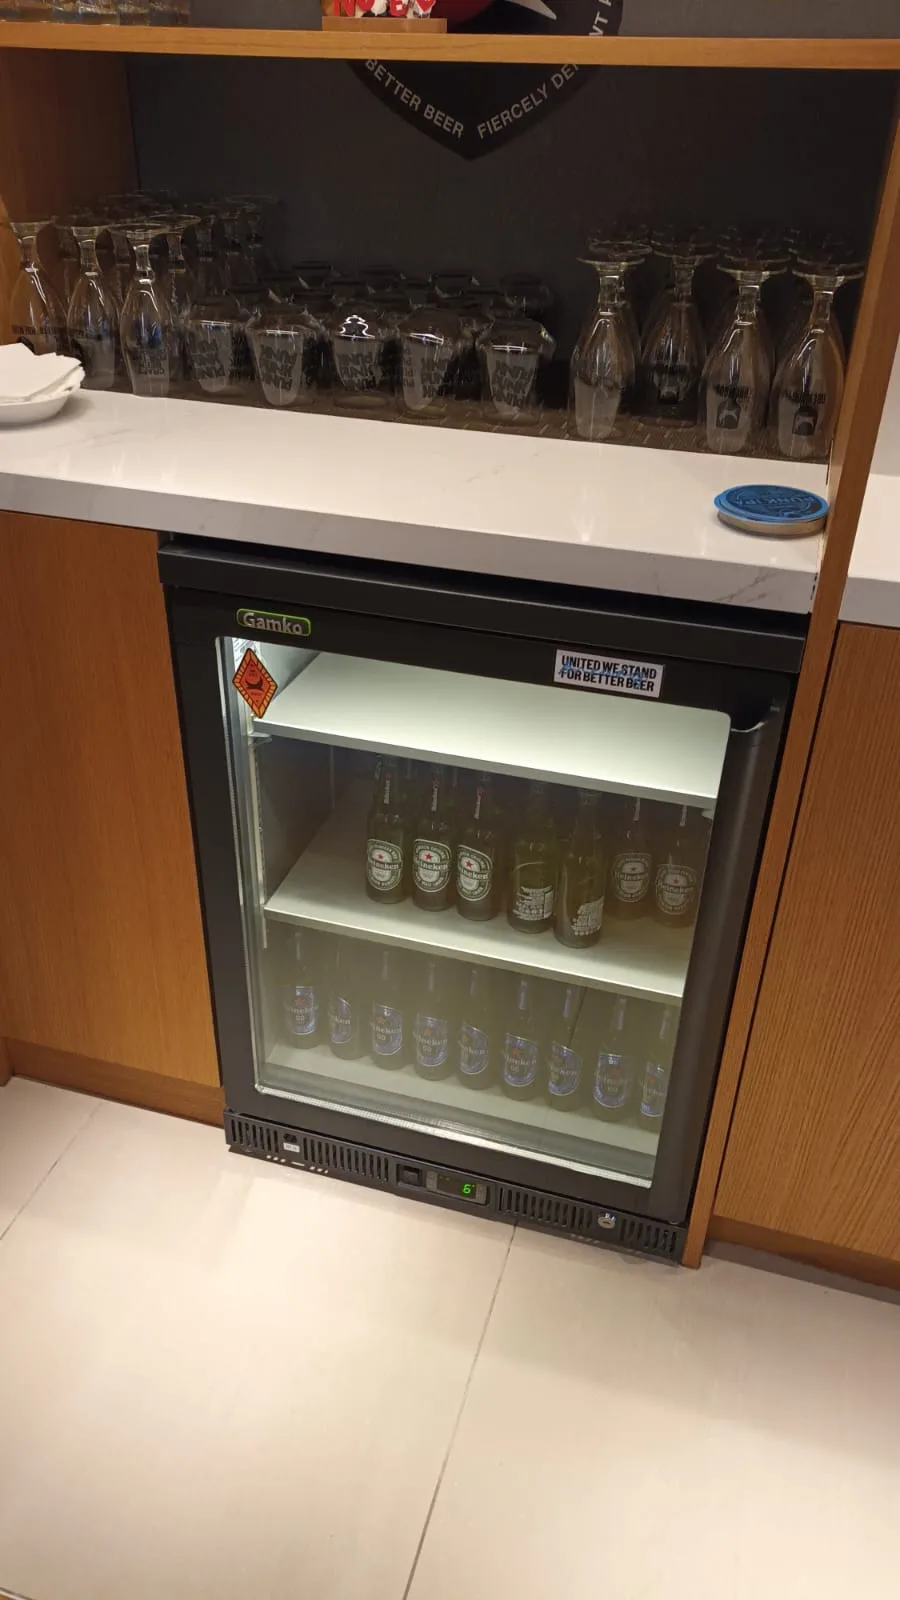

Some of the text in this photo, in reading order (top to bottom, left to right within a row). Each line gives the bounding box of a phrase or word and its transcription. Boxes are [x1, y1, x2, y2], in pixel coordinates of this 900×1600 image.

[365, 59, 464, 138] BETTER BEER
[477, 83, 548, 139] FIERCELY
[243, 612, 303, 635] Gamko
[559, 668, 655, 692] FOR BETTER BEER
[561, 655, 657, 680] UNITED WE STAND
